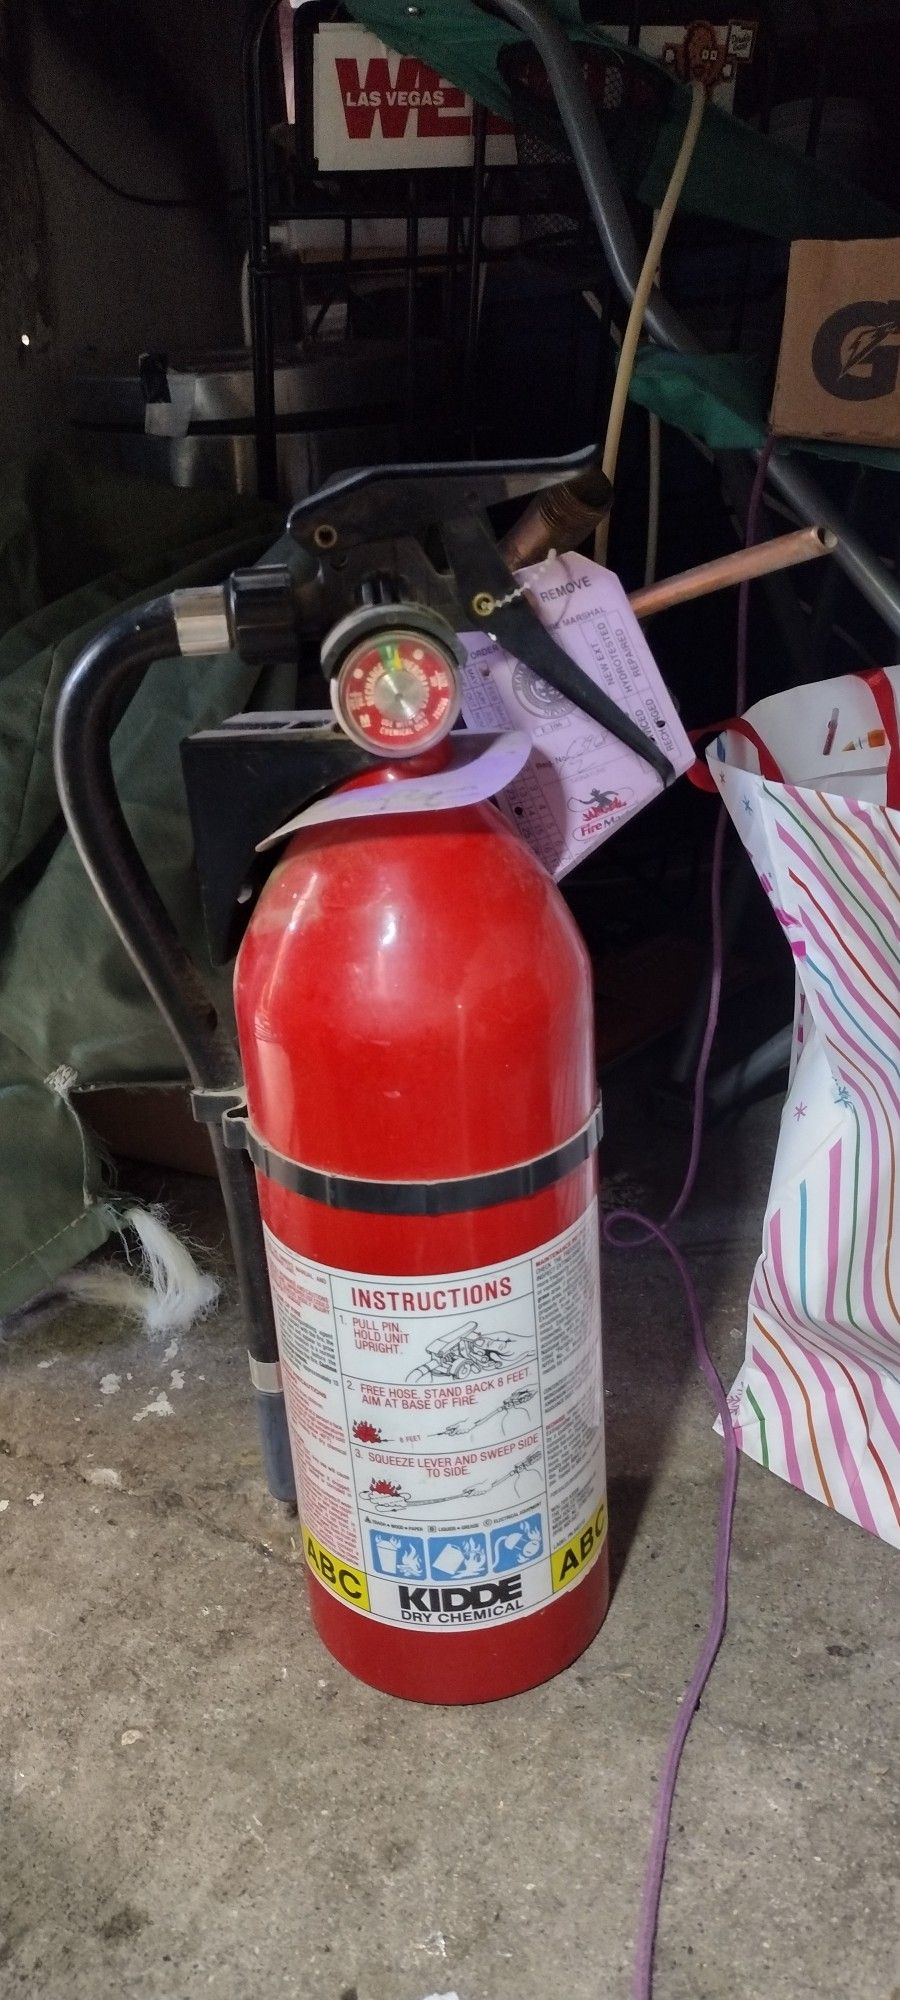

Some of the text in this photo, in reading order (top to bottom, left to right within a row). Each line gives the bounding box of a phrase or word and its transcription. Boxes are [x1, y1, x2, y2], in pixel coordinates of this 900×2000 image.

[346, 90, 445, 107] LAS VEGAS
[540, 576, 592, 603] REMOVE
[562, 607, 607, 627] MARSHAL
[470, 644, 499, 660] ORDER
[597, 622, 633, 694] HYDROTESTED
[600, 665, 615, 687] NEW
[615, 628, 674, 752] RECHRGED REPAIRED
[351, 1276, 512, 1312] INSTRUCTIONS
[339, 1314, 402, 1333] 1. PULL PIN.
[354, 1329, 410, 1344] HOLD UNIT
[355, 1339, 404, 1355] UPRIGHT.
[346, 1380, 356, 1391] 2.
[360, 1383, 386, 1398] FREE
[388, 1388, 421, 1400] HOSE.
[424, 1386, 462, 1400] STAND
[465, 1379, 495, 1395] BACK
[497, 1376, 504, 1388] 8
[361, 1394, 382, 1406] AIM
[384, 1397, 399, 1408] AT
[402, 1397, 432, 1410] BASE
[434, 1397, 448, 1409] OF
[405, 1434, 422, 1443] FEET
[354, 1432, 540, 1469] 3. SQUEEZE LEVER AND SWEEP SIDE
[426, 1466, 441, 1478] TO
[559, 1503, 605, 1582] ABC
[307, 1537, 362, 1600] ABC
[398, 1574, 523, 1613] KIDDE
[401, 1599, 525, 1624] DRY CHEMICAL
